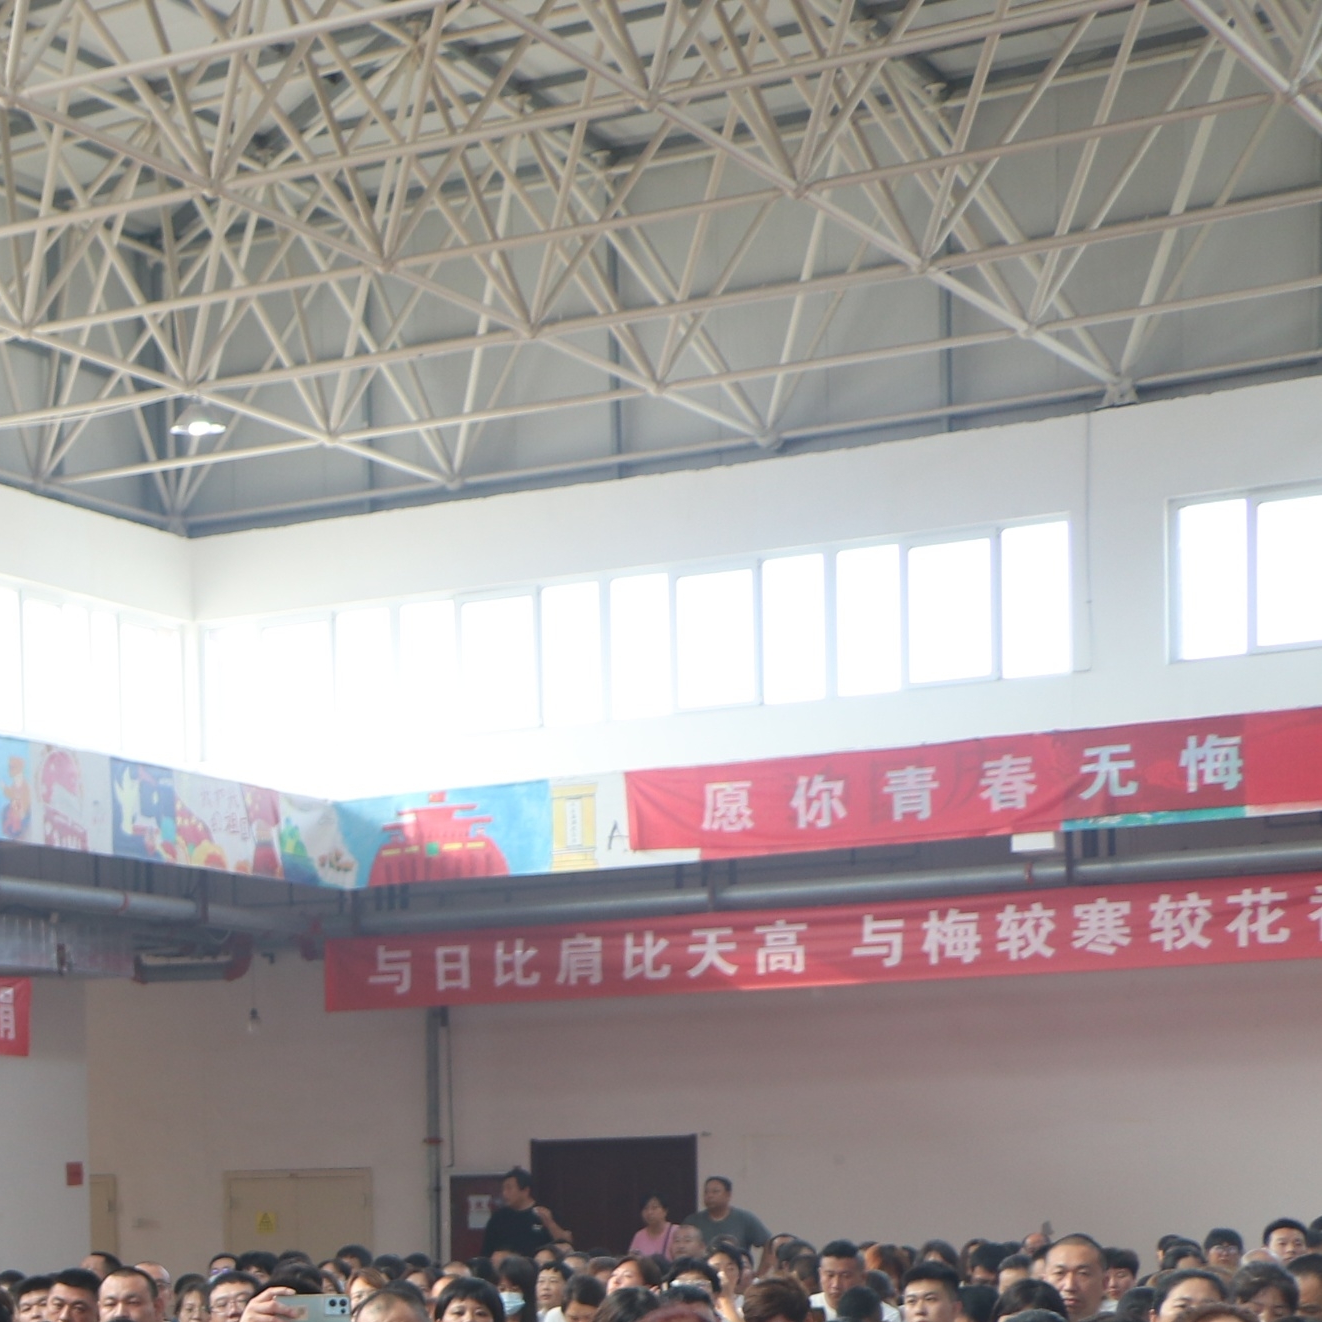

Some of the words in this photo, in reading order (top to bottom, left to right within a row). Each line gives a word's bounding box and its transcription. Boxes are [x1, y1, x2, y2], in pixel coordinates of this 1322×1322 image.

[701, 732, 1243, 831] 愿你青春无悔
[367, 919, 806, 994] 与日比肩比天高
